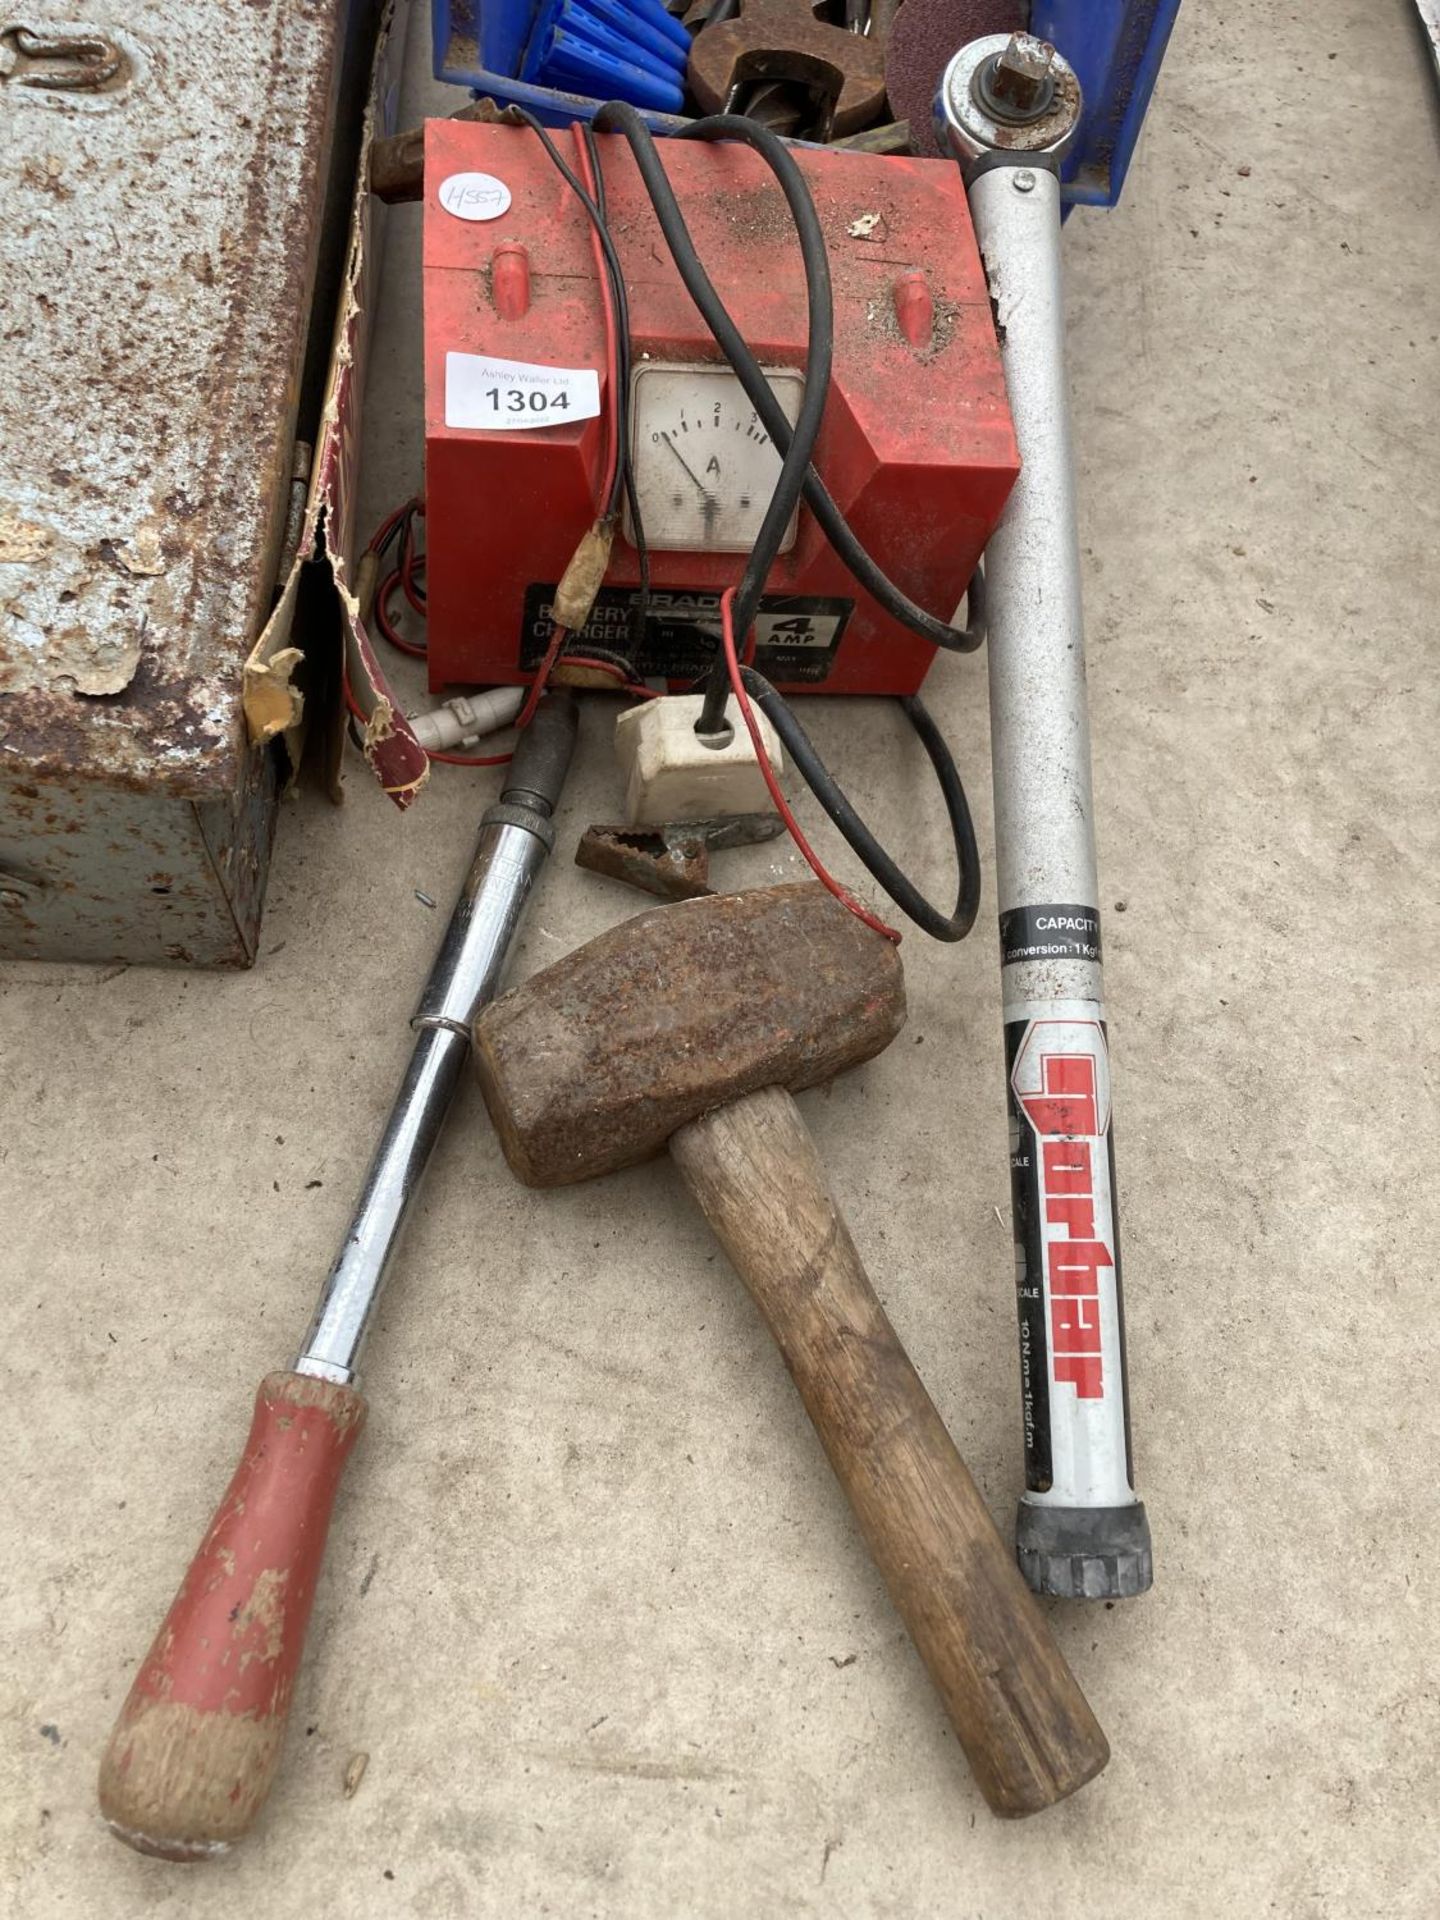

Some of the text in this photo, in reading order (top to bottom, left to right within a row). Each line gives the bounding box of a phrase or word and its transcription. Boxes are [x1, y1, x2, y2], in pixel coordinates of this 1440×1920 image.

[486, 388, 570, 412] 1304
[652, 432, 659, 443] 0
[713, 402, 721, 413] 2
[706, 456, 721, 473] A
[539, 603, 632, 622] BERY
[533, 621, 629, 639] CHRGER
[771, 617, 815, 634] 4
[768, 634, 815, 644] AMP
